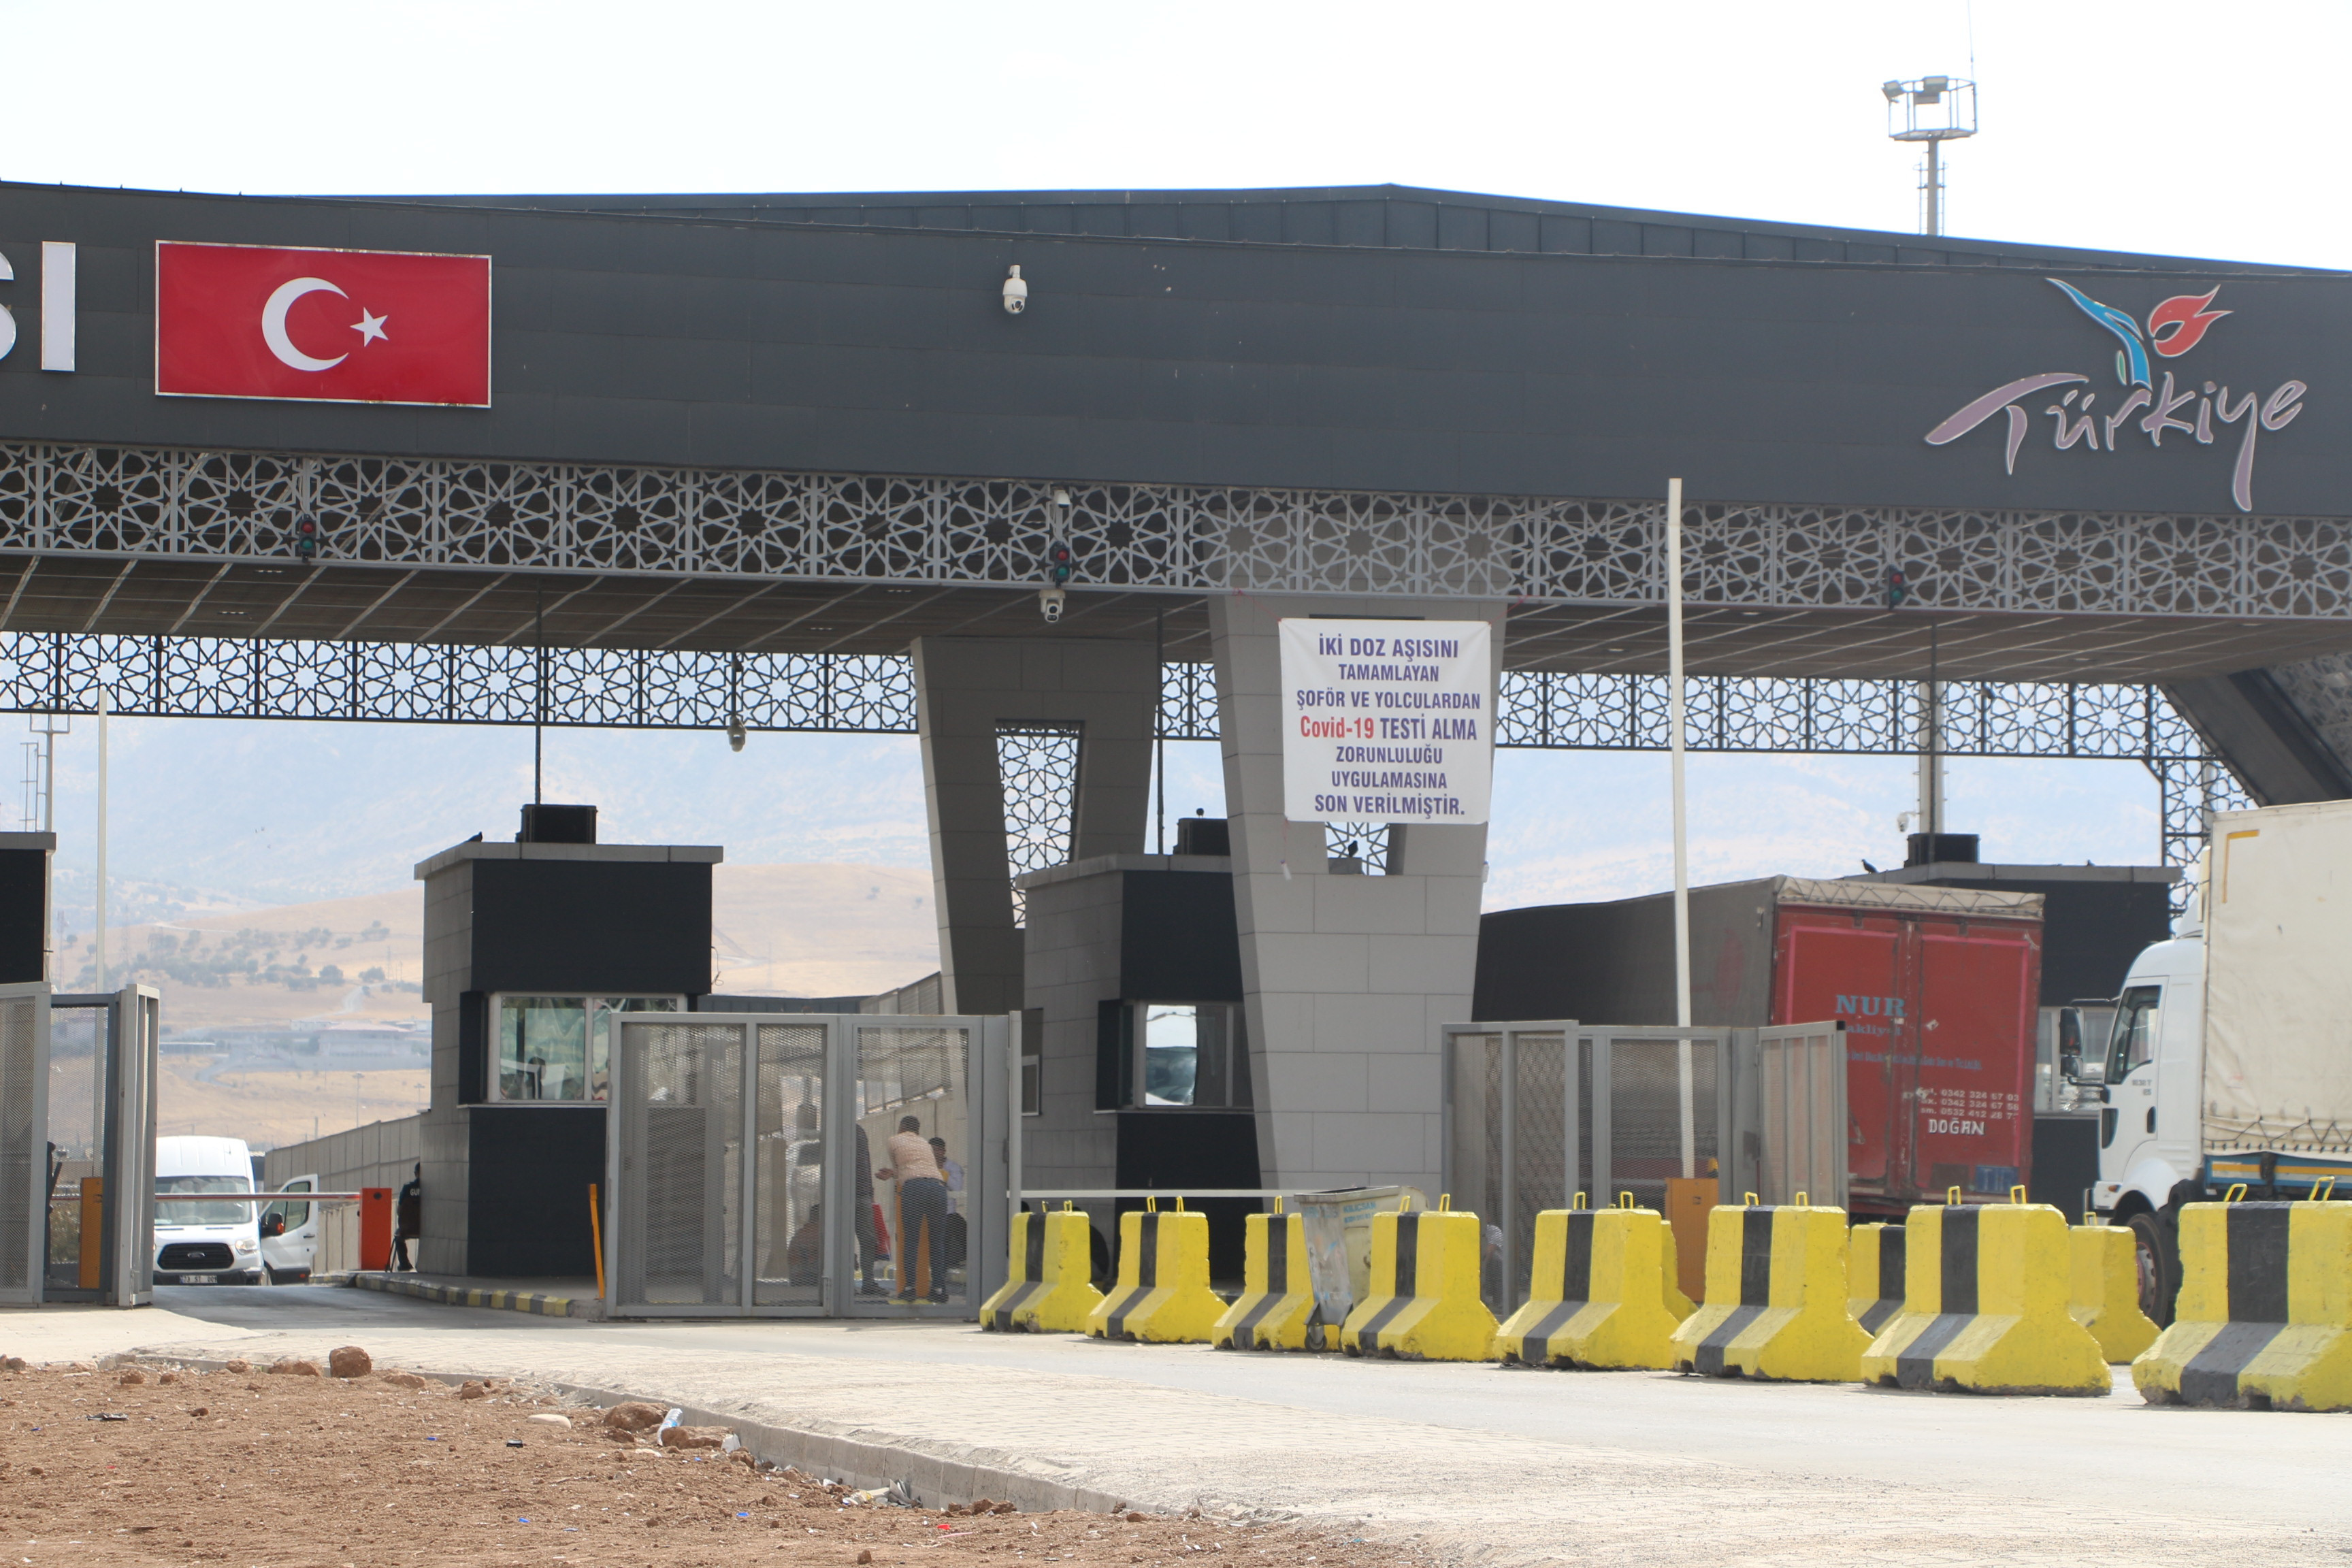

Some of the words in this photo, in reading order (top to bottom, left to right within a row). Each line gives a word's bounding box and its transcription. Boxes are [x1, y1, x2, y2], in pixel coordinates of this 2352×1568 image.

[1924, 372, 2307, 511] Türkiye
[1319, 632, 1343, 656] İKİ
[1350, 638, 1386, 657] DOZ
[1392, 638, 1458, 662] AŞISINI
[1338, 664, 1439, 682] TAMAMLAYAN
[1296, 687, 1345, 710] ŞOFÖR
[1350, 691, 1370, 708] VE
[1374, 691, 1481, 710] YOLCULARDAN
[1300, 715, 1375, 739] Covid-19
[1379, 713, 1426, 740] TESTİ
[1431, 718, 1477, 740] ALMA
[1335, 743, 1443, 764] ZORUNLULUĞU
[1331, 770, 1448, 789] UYGULAMASINA
[1314, 794, 1348, 813] SON
[1353, 793, 1465, 820] VERİLMİŞTİR.
[1835, 994, 1908, 1017] NUR
[1941, 1089, 1965, 1098] 0342
[1970, 1090, 1987, 1099] 324
[2007, 1094, 2019, 1102] 03
[1941, 1098, 1965, 1107] 0342
[1970, 1100, 1987, 1109] 324
[1991, 1102, 2003, 1110] 67
[1941, 1107, 1965, 1117] 0532
[1969, 1109, 1987, 1118] 412
[1990, 1111, 2003, 1120] 28
[1928, 1117, 1986, 1135] DOĞAN
